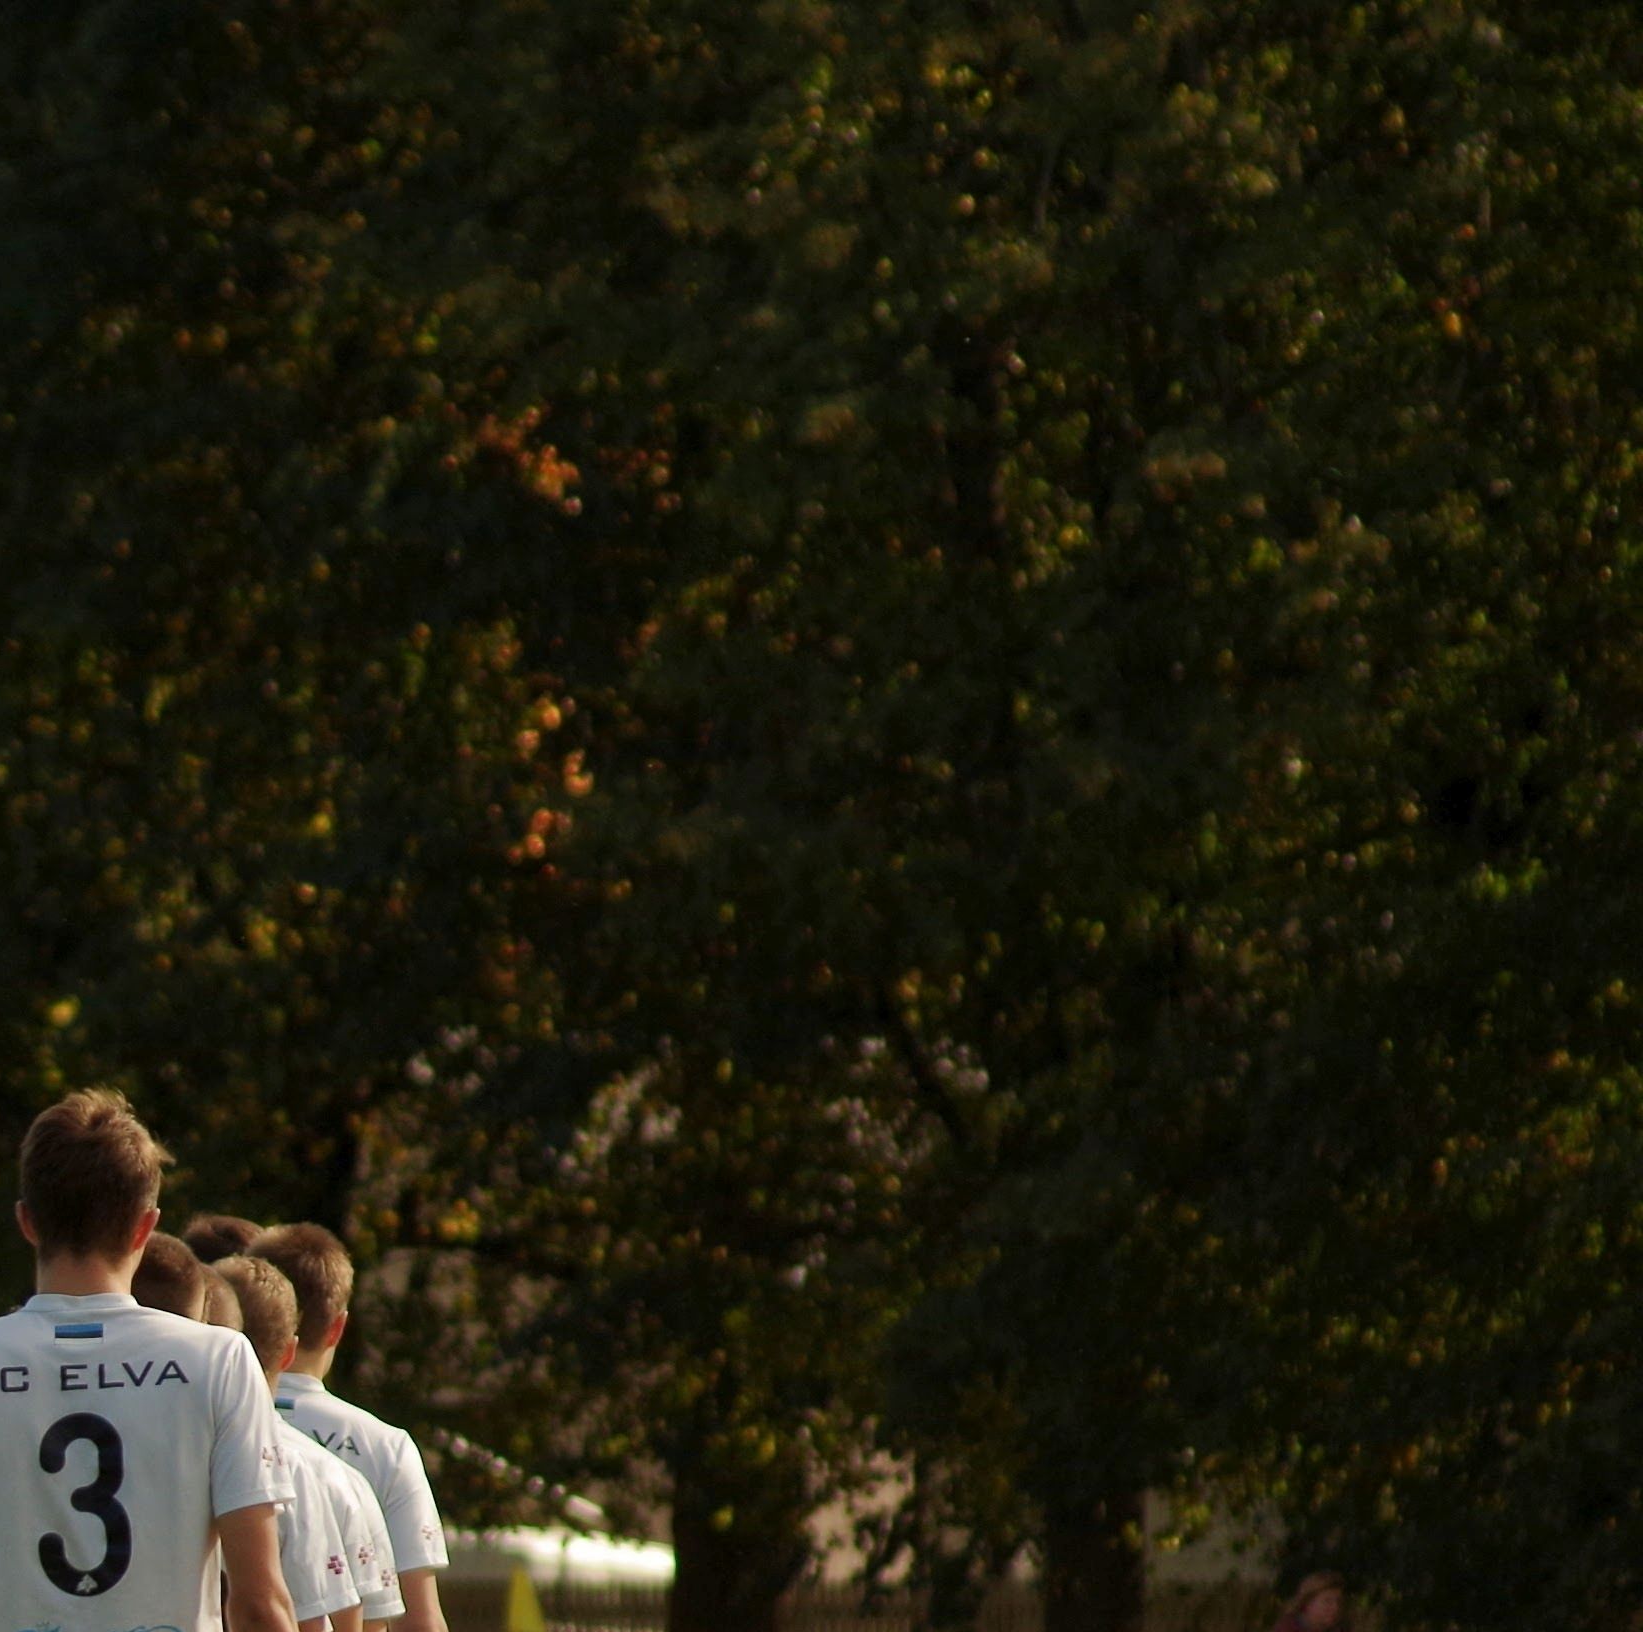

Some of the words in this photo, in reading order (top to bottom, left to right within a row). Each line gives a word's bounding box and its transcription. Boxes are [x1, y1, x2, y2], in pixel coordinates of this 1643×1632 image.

[60, 1360, 190, 1391] ELVA
[312, 1429, 361, 1456] VA
[38, 1412, 132, 1597] 3
